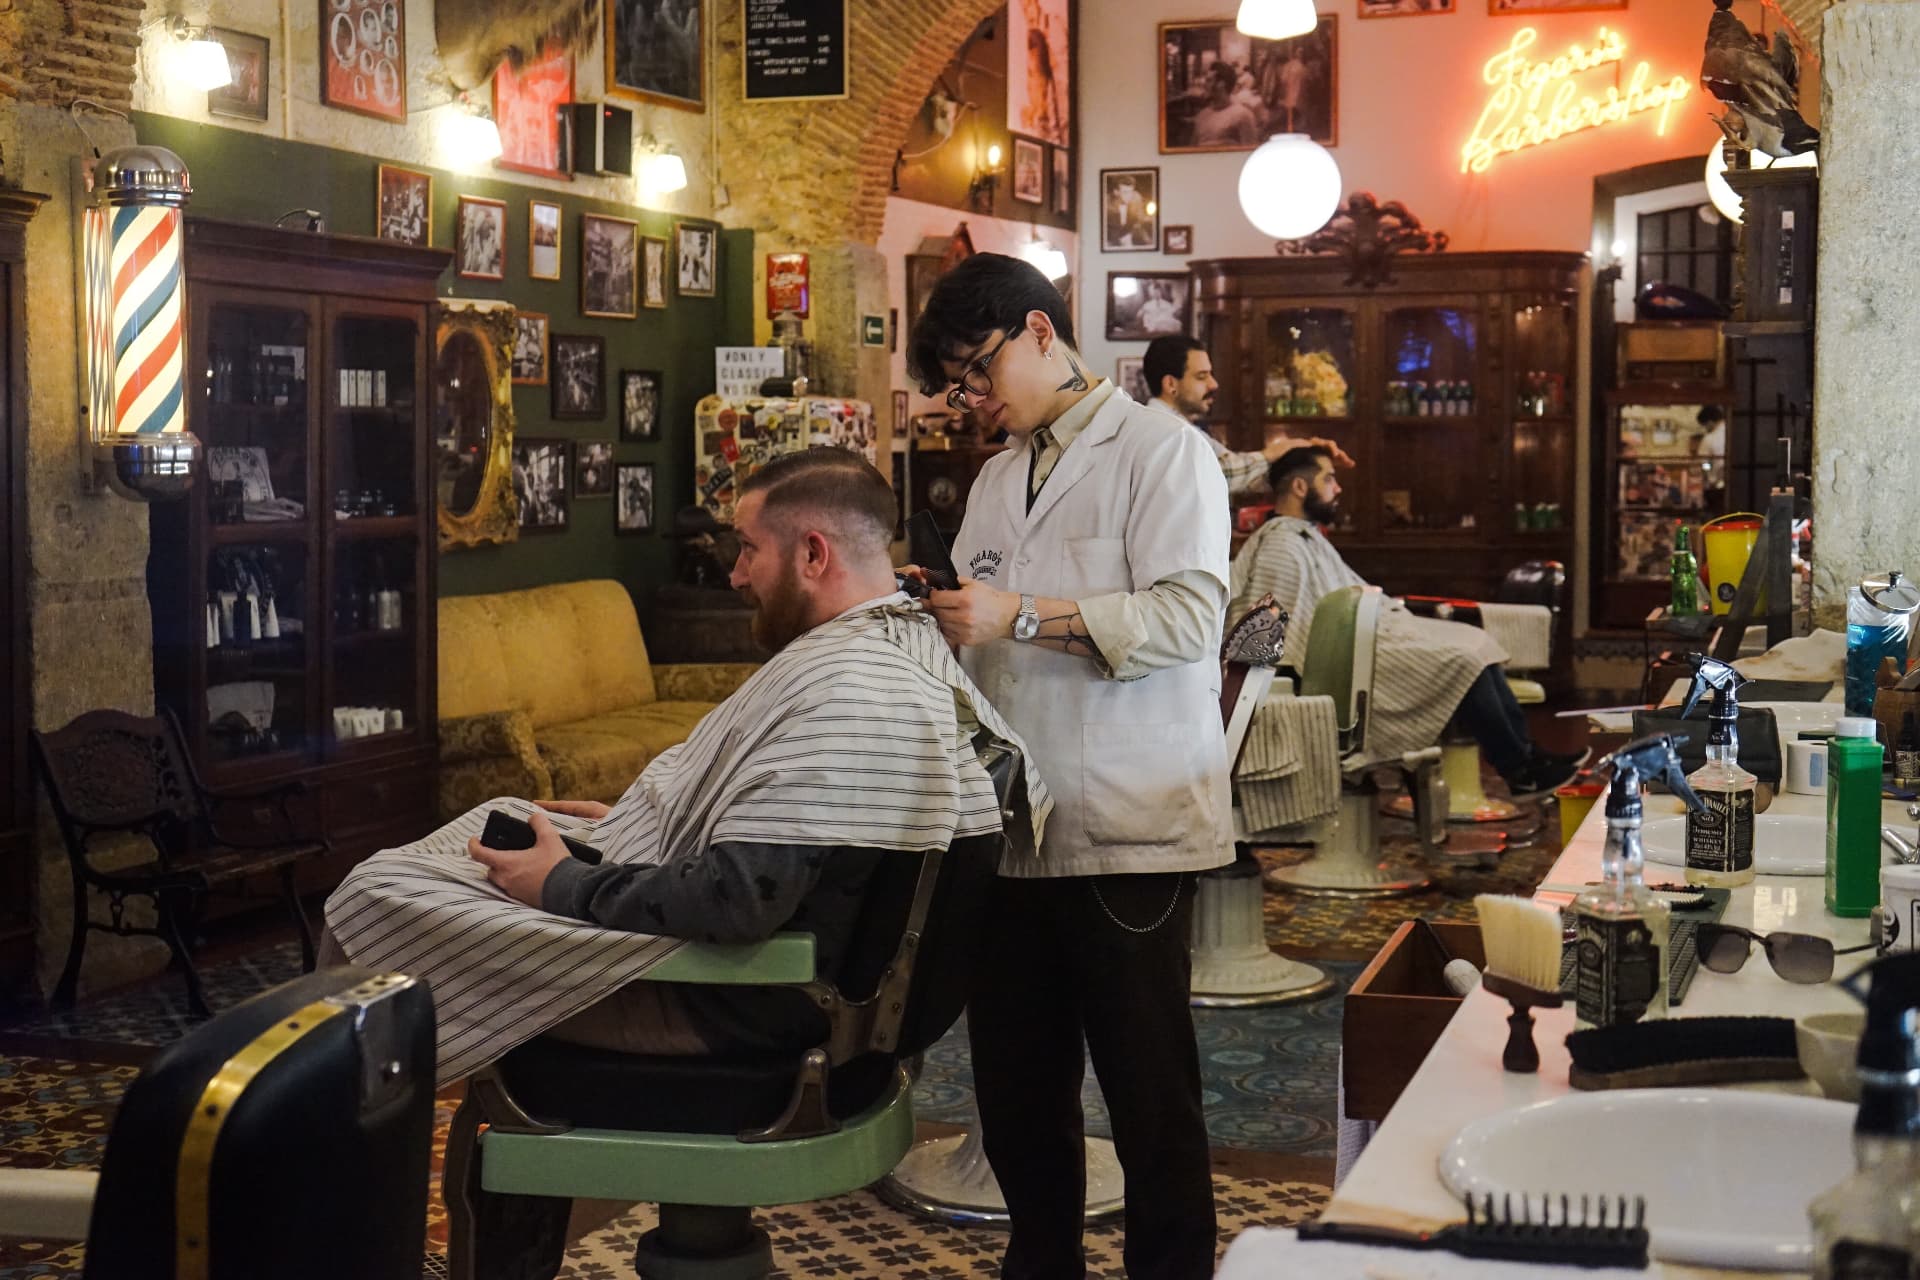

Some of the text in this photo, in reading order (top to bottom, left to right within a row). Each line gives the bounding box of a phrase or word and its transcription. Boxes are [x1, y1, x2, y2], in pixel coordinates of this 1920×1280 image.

[1483, 26, 1627, 110] Figaro's
[1460, 61, 1692, 174] Barbershop
[969, 549, 1003, 570] FIGARO'S
